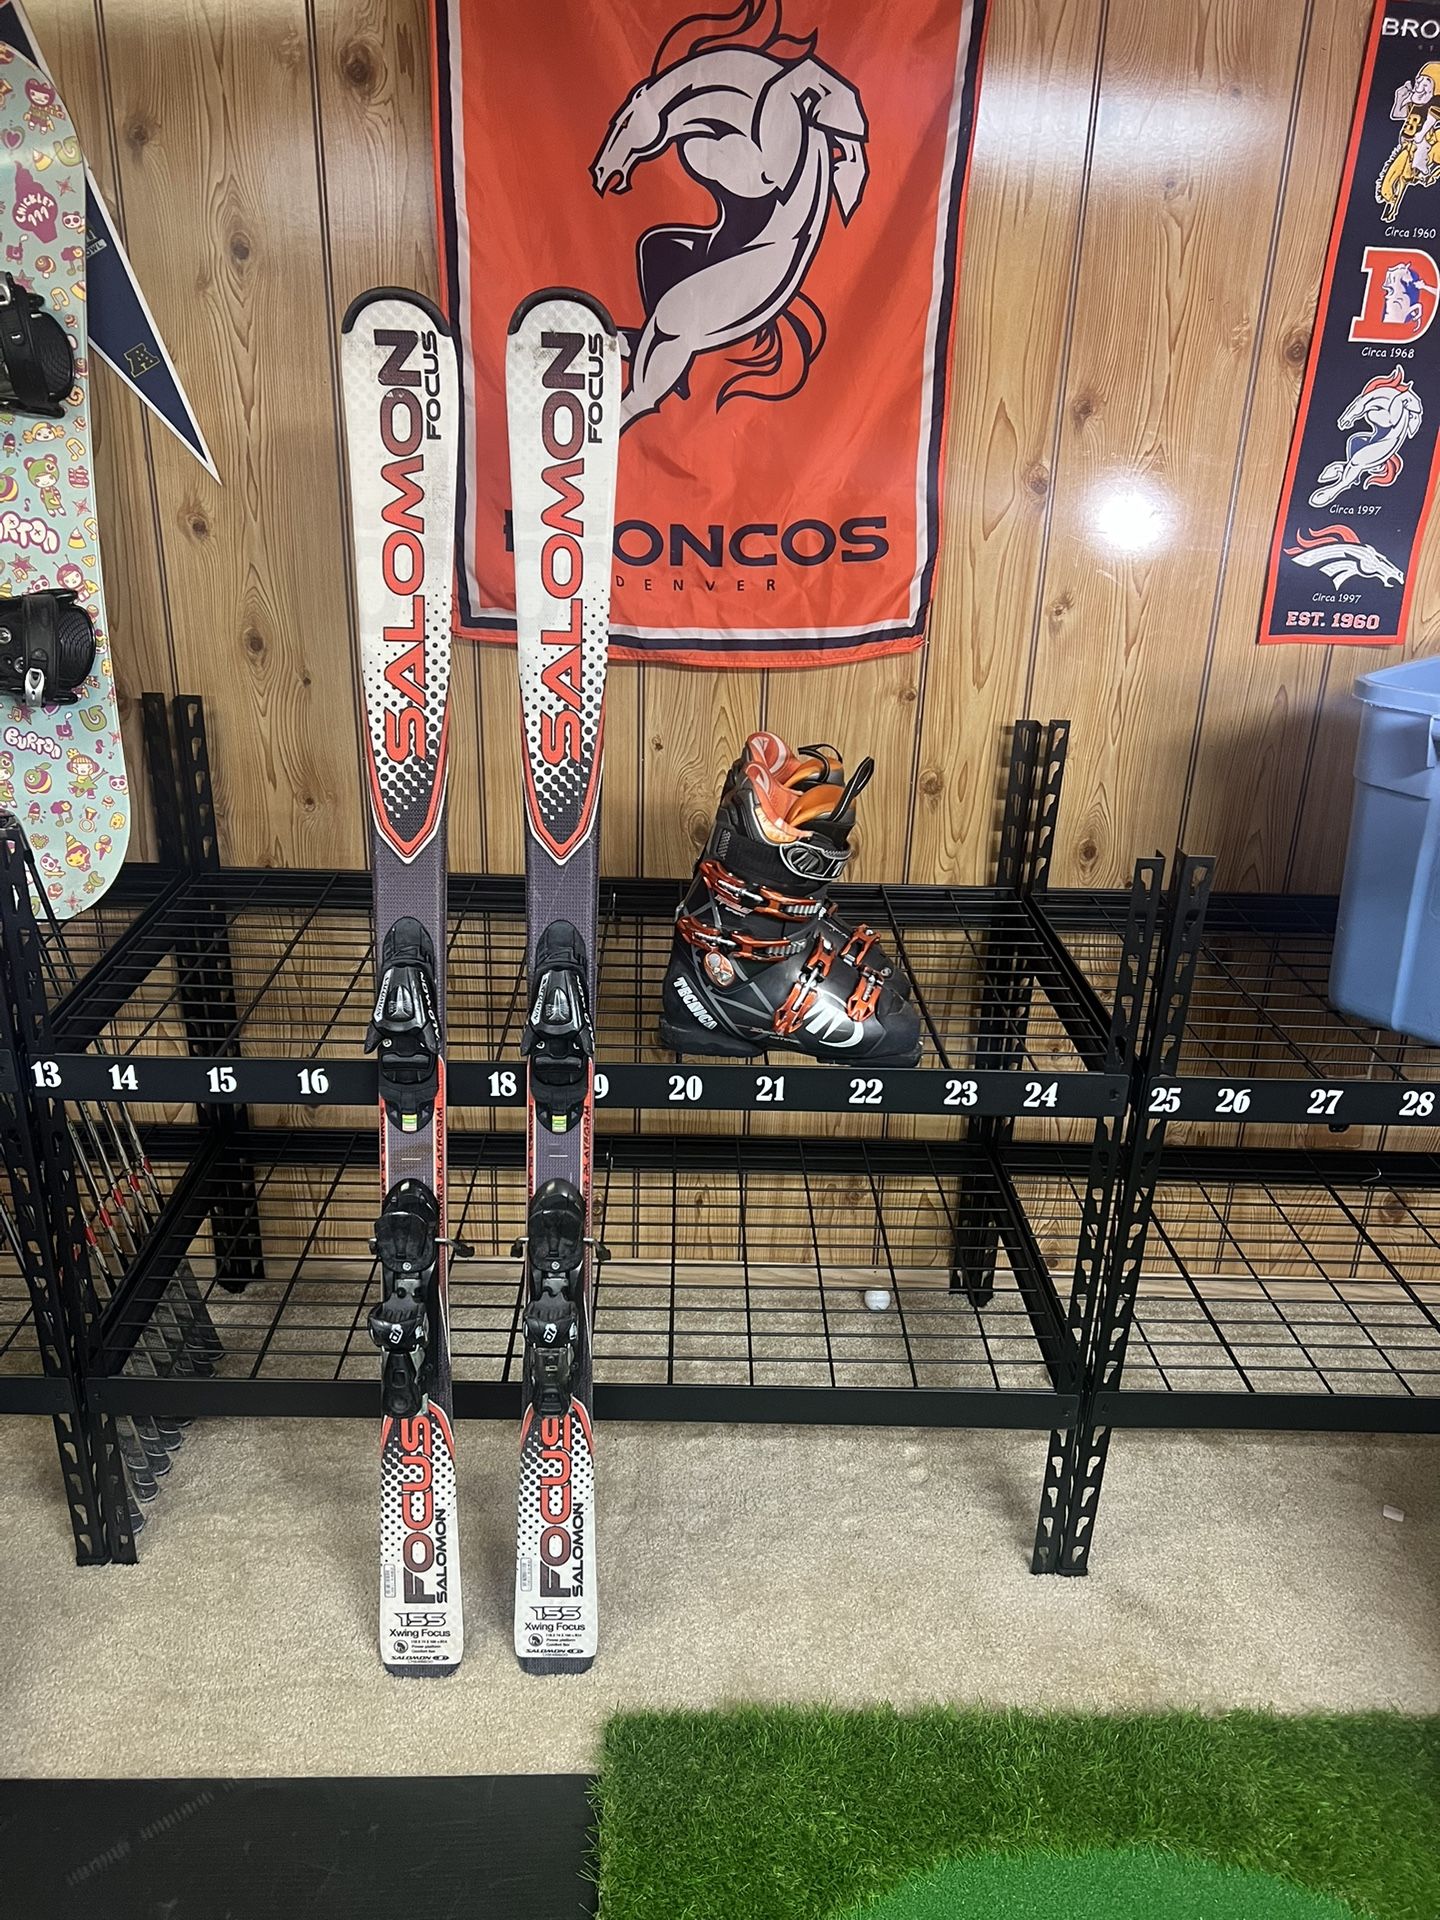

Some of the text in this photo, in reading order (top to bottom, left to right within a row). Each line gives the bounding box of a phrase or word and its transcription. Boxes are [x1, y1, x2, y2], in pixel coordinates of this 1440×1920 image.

[1382, 17, 1440, 39] BRO
[15, 193, 55, 223] CHICKLET
[1384, 226, 1437, 240] Circa 1960
[86, 242, 104, 256] OWL
[1361, 346, 1415, 359] Circa 1968
[422, 329, 442, 440] FOCUS
[588, 333, 604, 444] FOCUS
[1329, 503, 1382, 516] Circa 1997
[0, 511, 60, 554] RTON
[504, 509, 890, 568] ONCOS
[374, 329, 426, 763] SALOMON
[541, 331, 586, 765] SALOMON
[615, 574, 777, 593] DENVER
[1312, 592, 1362, 604] Circa 1997
[1286, 611, 1380, 630] EST. 1960
[673, 976, 718, 1031] TECNICA
[31, 1061, 61, 1088] 13
[108, 1063, 138, 1090] 14
[207, 1066, 237, 1093] 15
[298, 1068, 329, 1094] 16
[488, 1071, 517, 1097] 18
[593, 1074, 609, 1099] 9
[668, 1075, 703, 1101] 20
[755, 1076, 785, 1101] 21
[849, 1078, 883, 1104] 22
[944, 1080, 978, 1106] 23
[1023, 1082, 1058, 1108] 24
[1149, 1087, 1181, 1112] 25
[1215, 1088, 1251, 1113] 26
[1307, 1089, 1343, 1115] 27
[1399, 1091, 1435, 1116] 28
[401, 1415, 436, 1604] FOCUS
[540, 1417, 572, 1598] FOCUS
[435, 1508, 448, 1604] SALOMON
[572, 1502, 584, 1597] SALOMON
[394, 1612, 447, 1627] 155
[529, 1606, 582, 1620] 155
[389, 1628, 451, 1639] Xwing Focus
[525, 1622, 585, 1632] Xwing Focus
